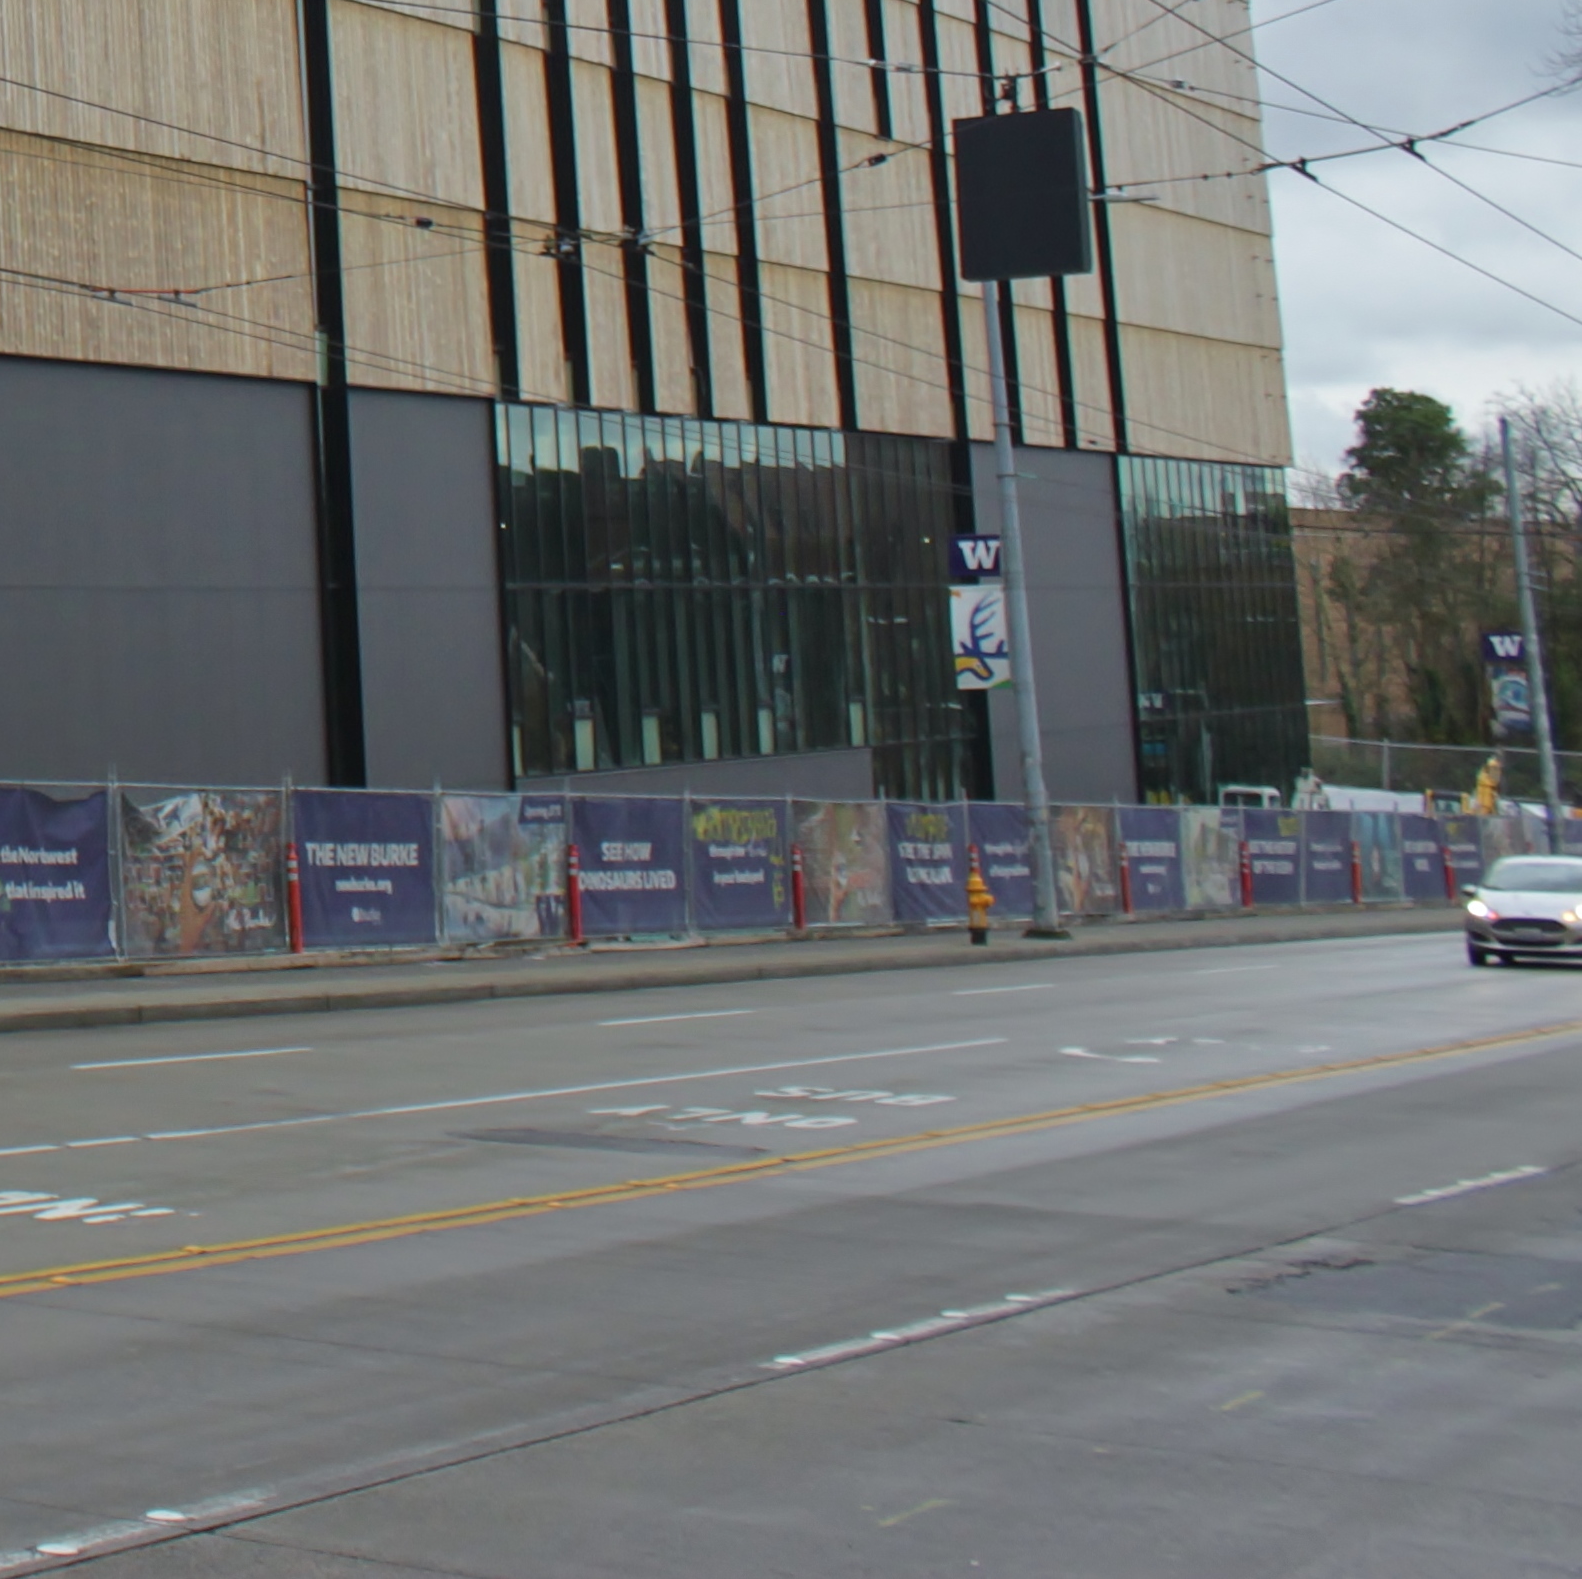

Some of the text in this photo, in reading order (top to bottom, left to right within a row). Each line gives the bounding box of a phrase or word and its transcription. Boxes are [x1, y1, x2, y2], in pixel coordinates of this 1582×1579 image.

[958, 539, 1002, 570] W
[1489, 634, 1522, 657] W
[305, 842, 420, 866] THE NEW BURKE
